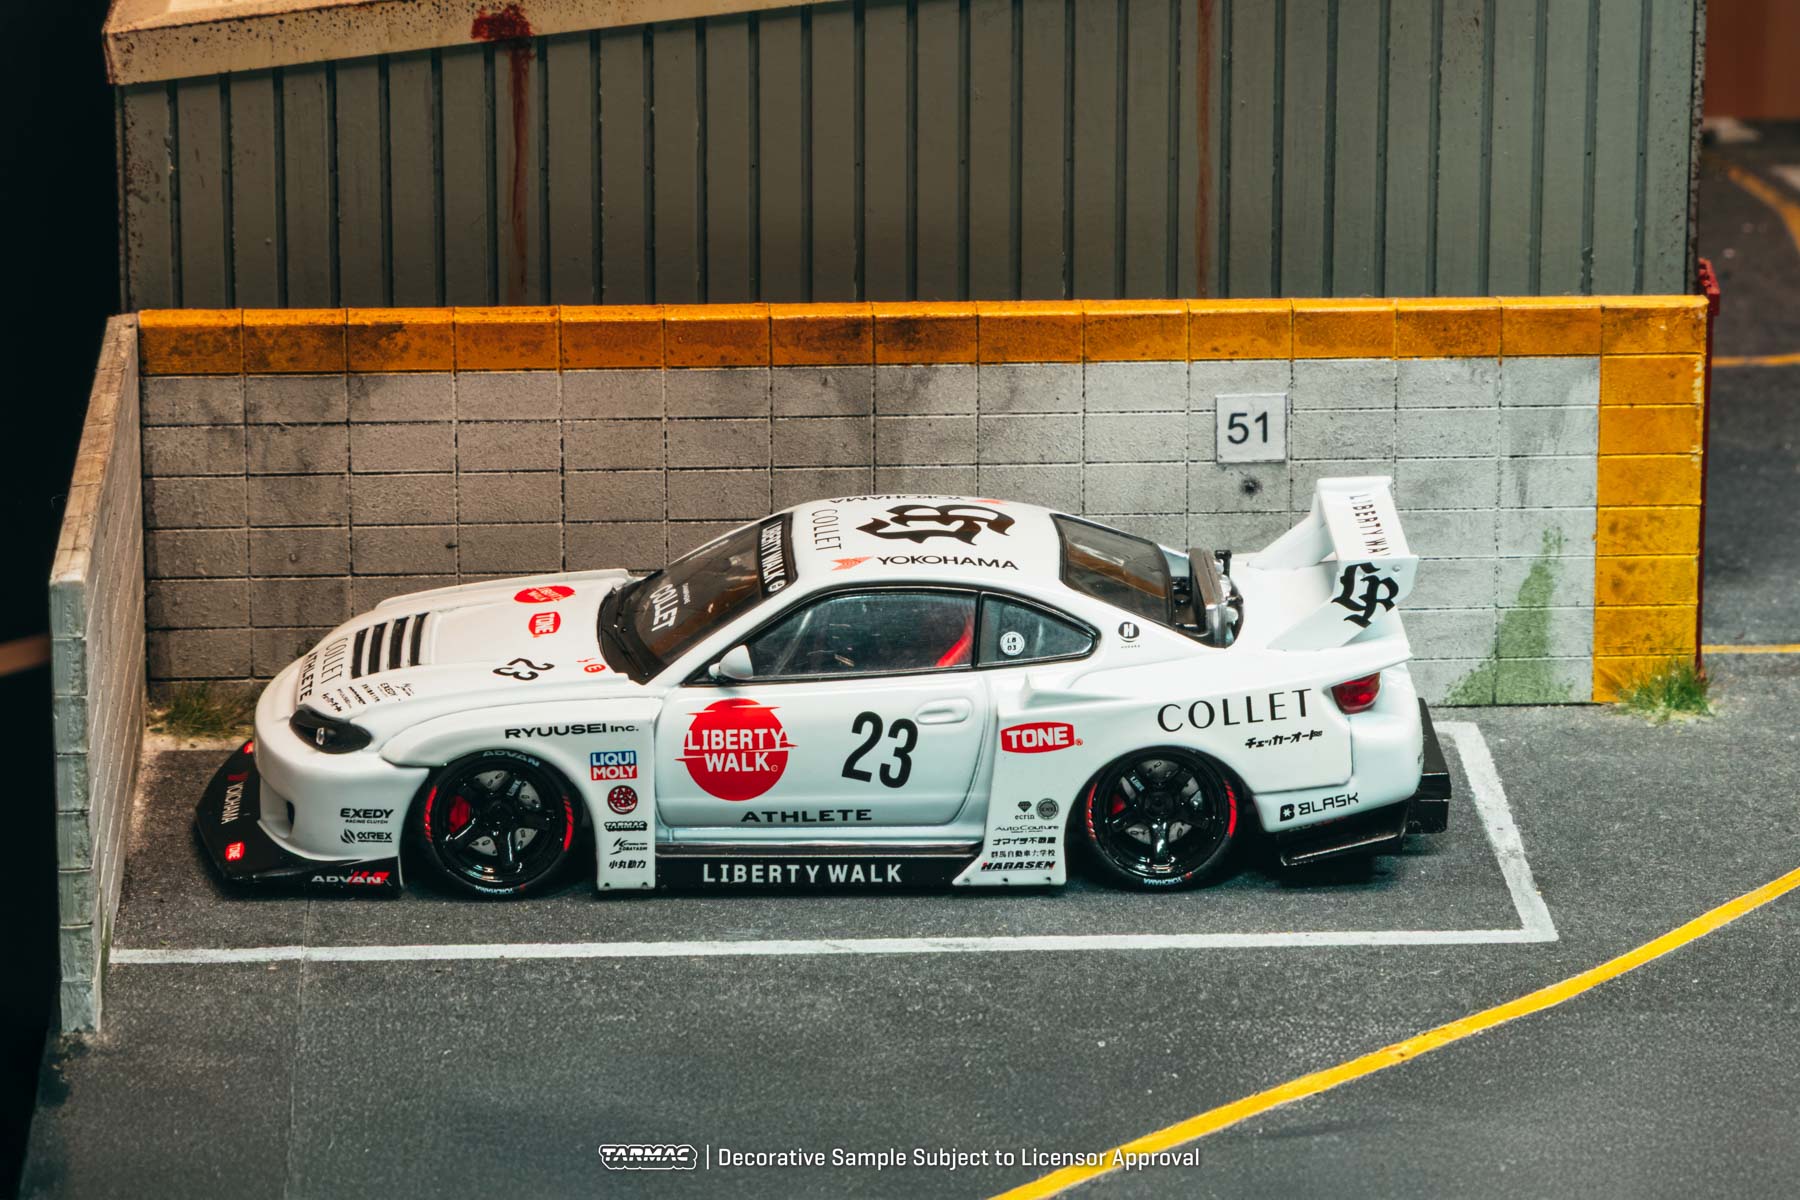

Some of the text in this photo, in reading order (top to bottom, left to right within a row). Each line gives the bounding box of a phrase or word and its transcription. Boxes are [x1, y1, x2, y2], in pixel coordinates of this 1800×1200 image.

[1226, 411, 1268, 444] 51
[811, 508, 842, 551] COLLET
[761, 550, 786, 584] WALK
[877, 555, 1020, 570] YOKOHAMA
[650, 583, 679, 632] COLLET
[535, 613, 555, 634] TONE
[320, 637, 348, 685] COLLET
[493, 657, 555, 681] 23
[1157, 688, 1312, 732] COLLET
[505, 723, 606, 739] RYUUSEI
[687, 728, 784, 751] LIBERTY
[1007, 726, 1069, 749] TONE
[482, 750, 540, 767] ADVAN
[592, 751, 635, 766] LIQUI
[841, 711, 919, 789] 23
[593, 765, 636, 780] MOLY
[704, 752, 770, 773] WALK
[220, 781, 244, 825] YOKOHAMA
[340, 808, 394, 818] EXEDY
[604, 821, 648, 832] TARMAC
[741, 809, 872, 823] ATHLETE
[703, 864, 902, 884] LIBERTY WALK
[980, 861, 1057, 872] HARASEN
[311, 875, 382, 884] ADVAN
